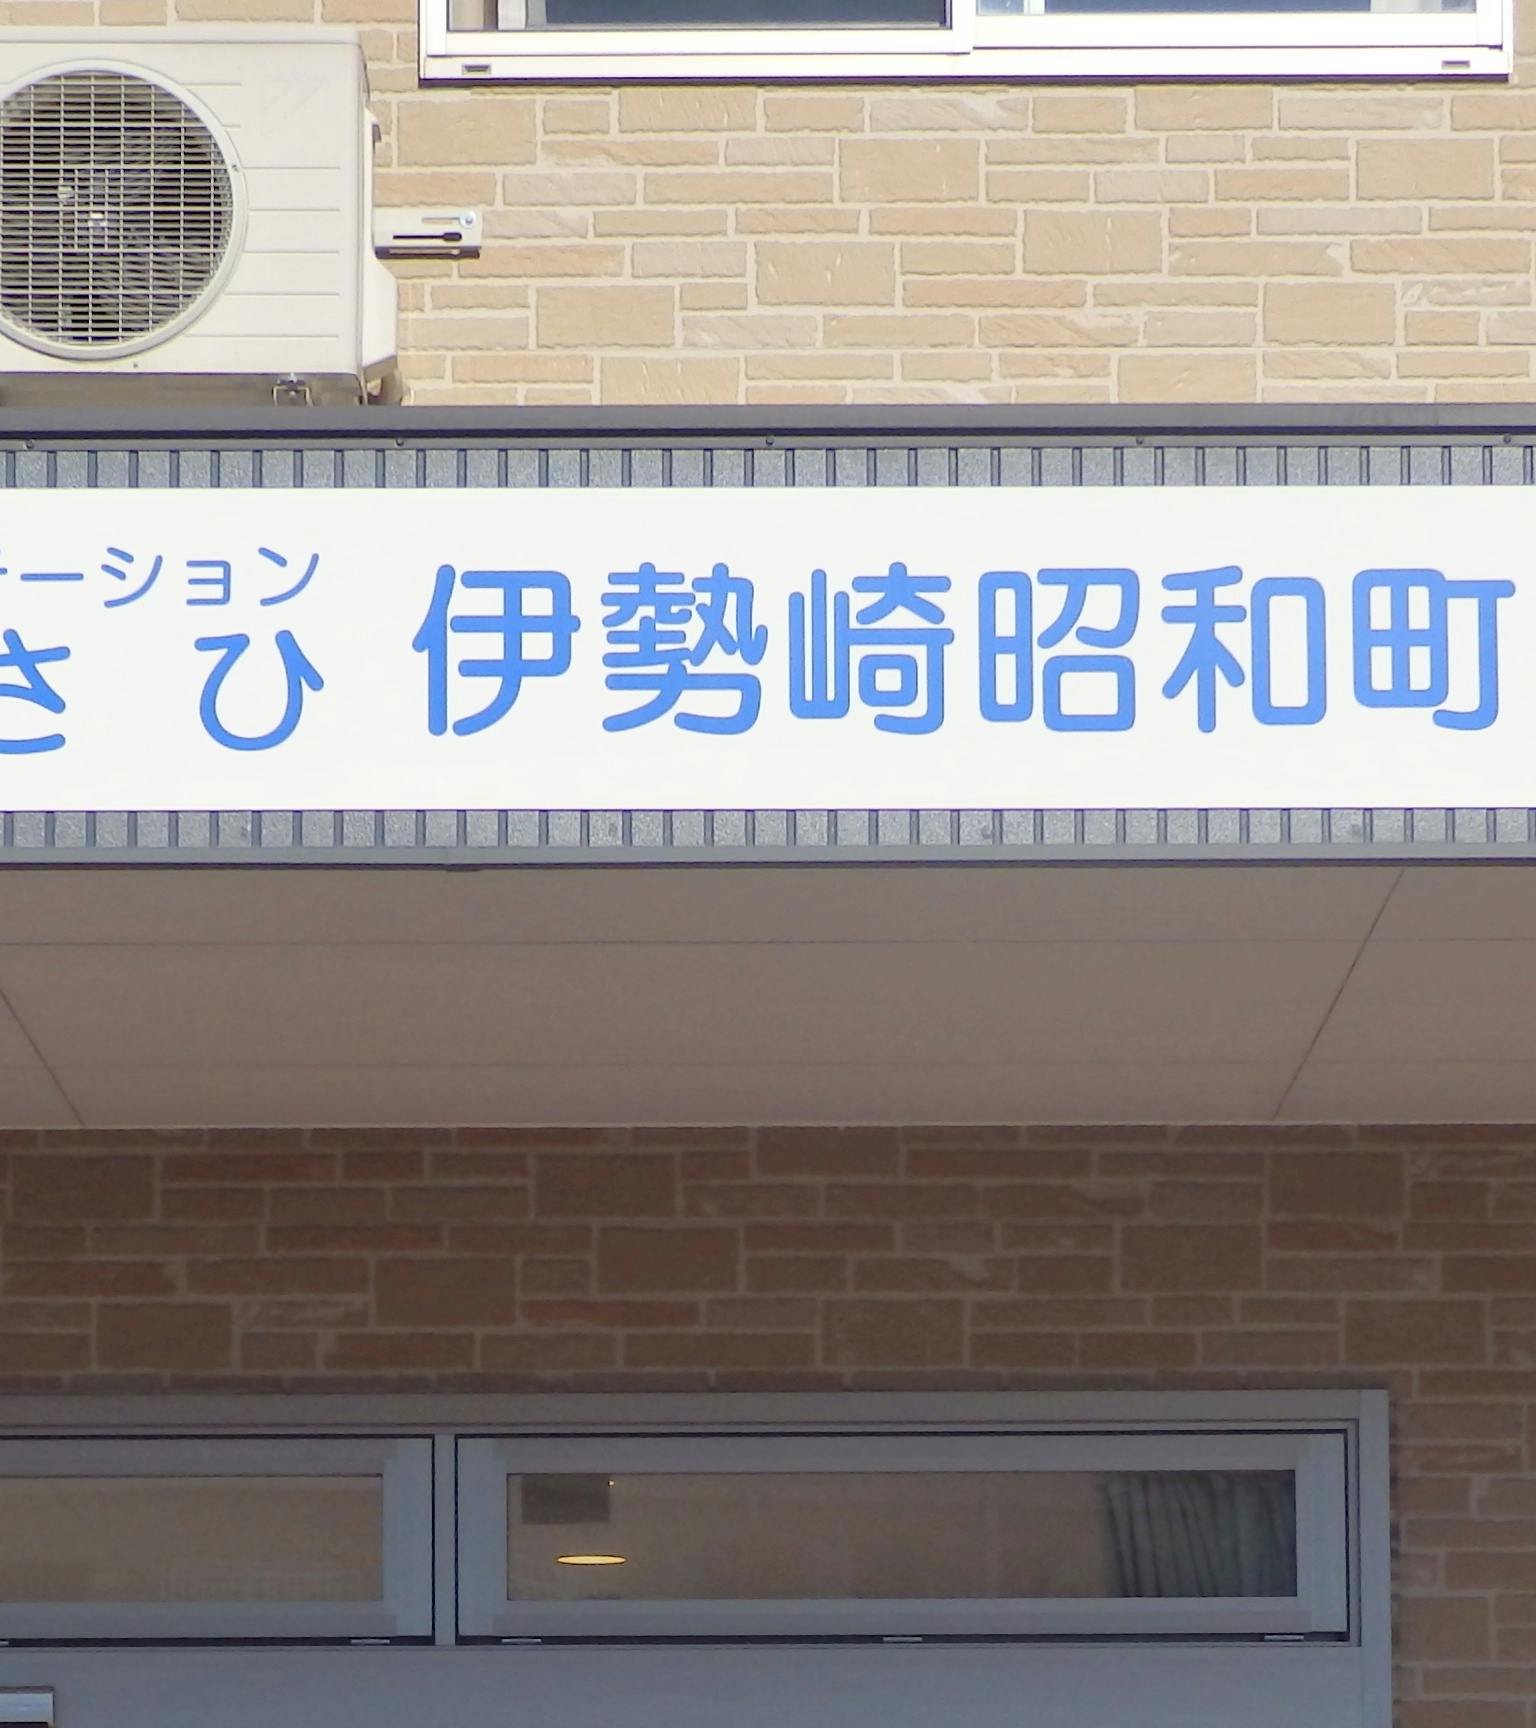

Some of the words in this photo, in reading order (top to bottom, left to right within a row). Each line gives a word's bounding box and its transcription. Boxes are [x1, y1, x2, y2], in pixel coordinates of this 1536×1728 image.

[412, 562, 1516, 737] 伊勢崎昭和町
